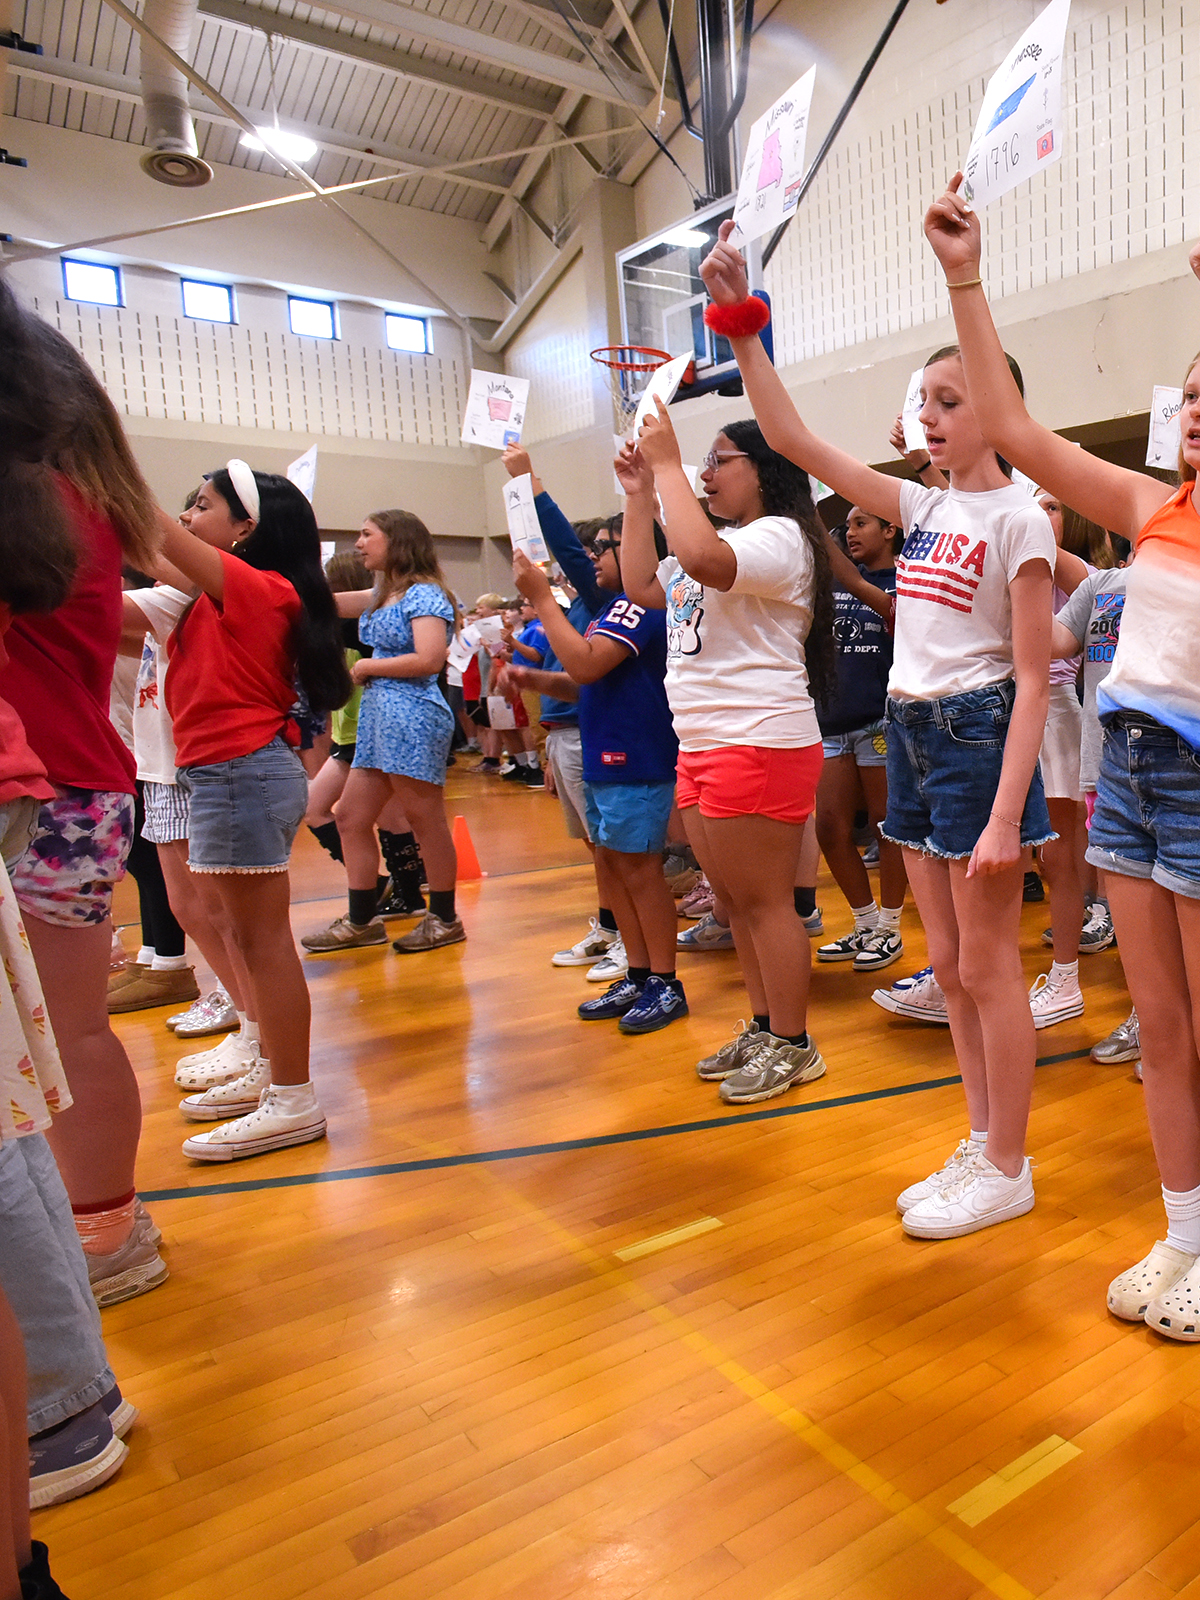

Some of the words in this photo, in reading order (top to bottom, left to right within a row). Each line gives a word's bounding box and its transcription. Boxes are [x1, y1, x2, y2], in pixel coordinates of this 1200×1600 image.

[985, 132, 1020, 187] 1796
[931, 532, 988, 577] USA
[605, 600, 646, 629] 25
[854, 645, 881, 653] DEPT.
